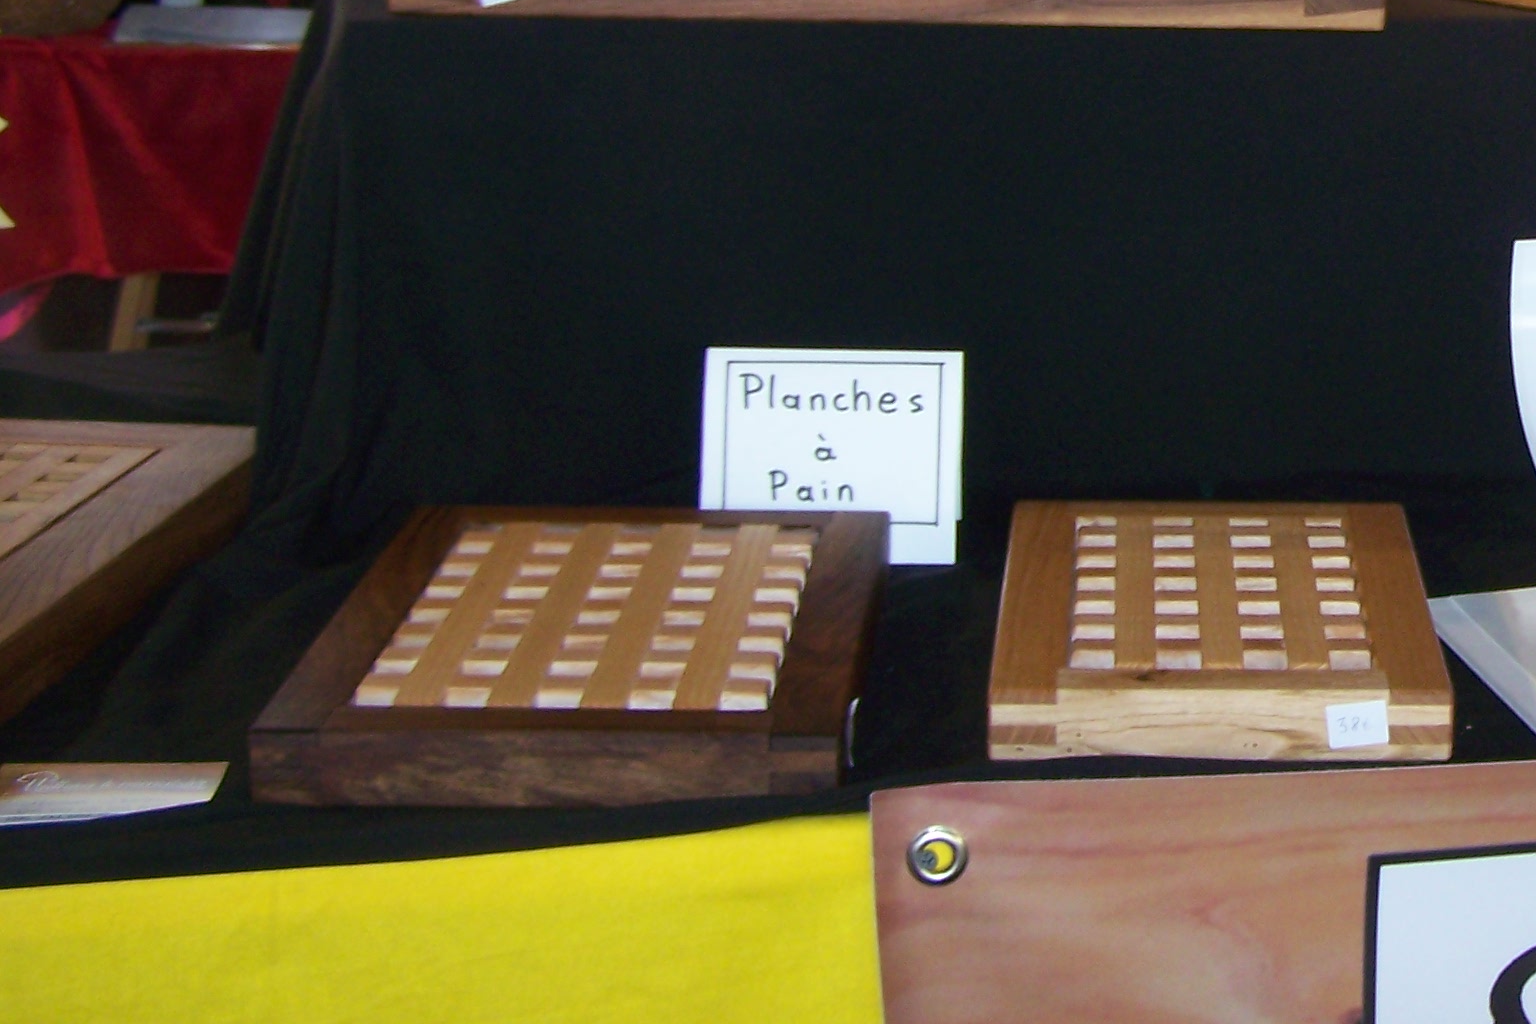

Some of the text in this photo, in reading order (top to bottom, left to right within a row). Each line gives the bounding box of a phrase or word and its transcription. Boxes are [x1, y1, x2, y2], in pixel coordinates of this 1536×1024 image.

[738, 372, 925, 414] Planches
[814, 432, 837, 462] à
[768, 469, 854, 502] Pain
